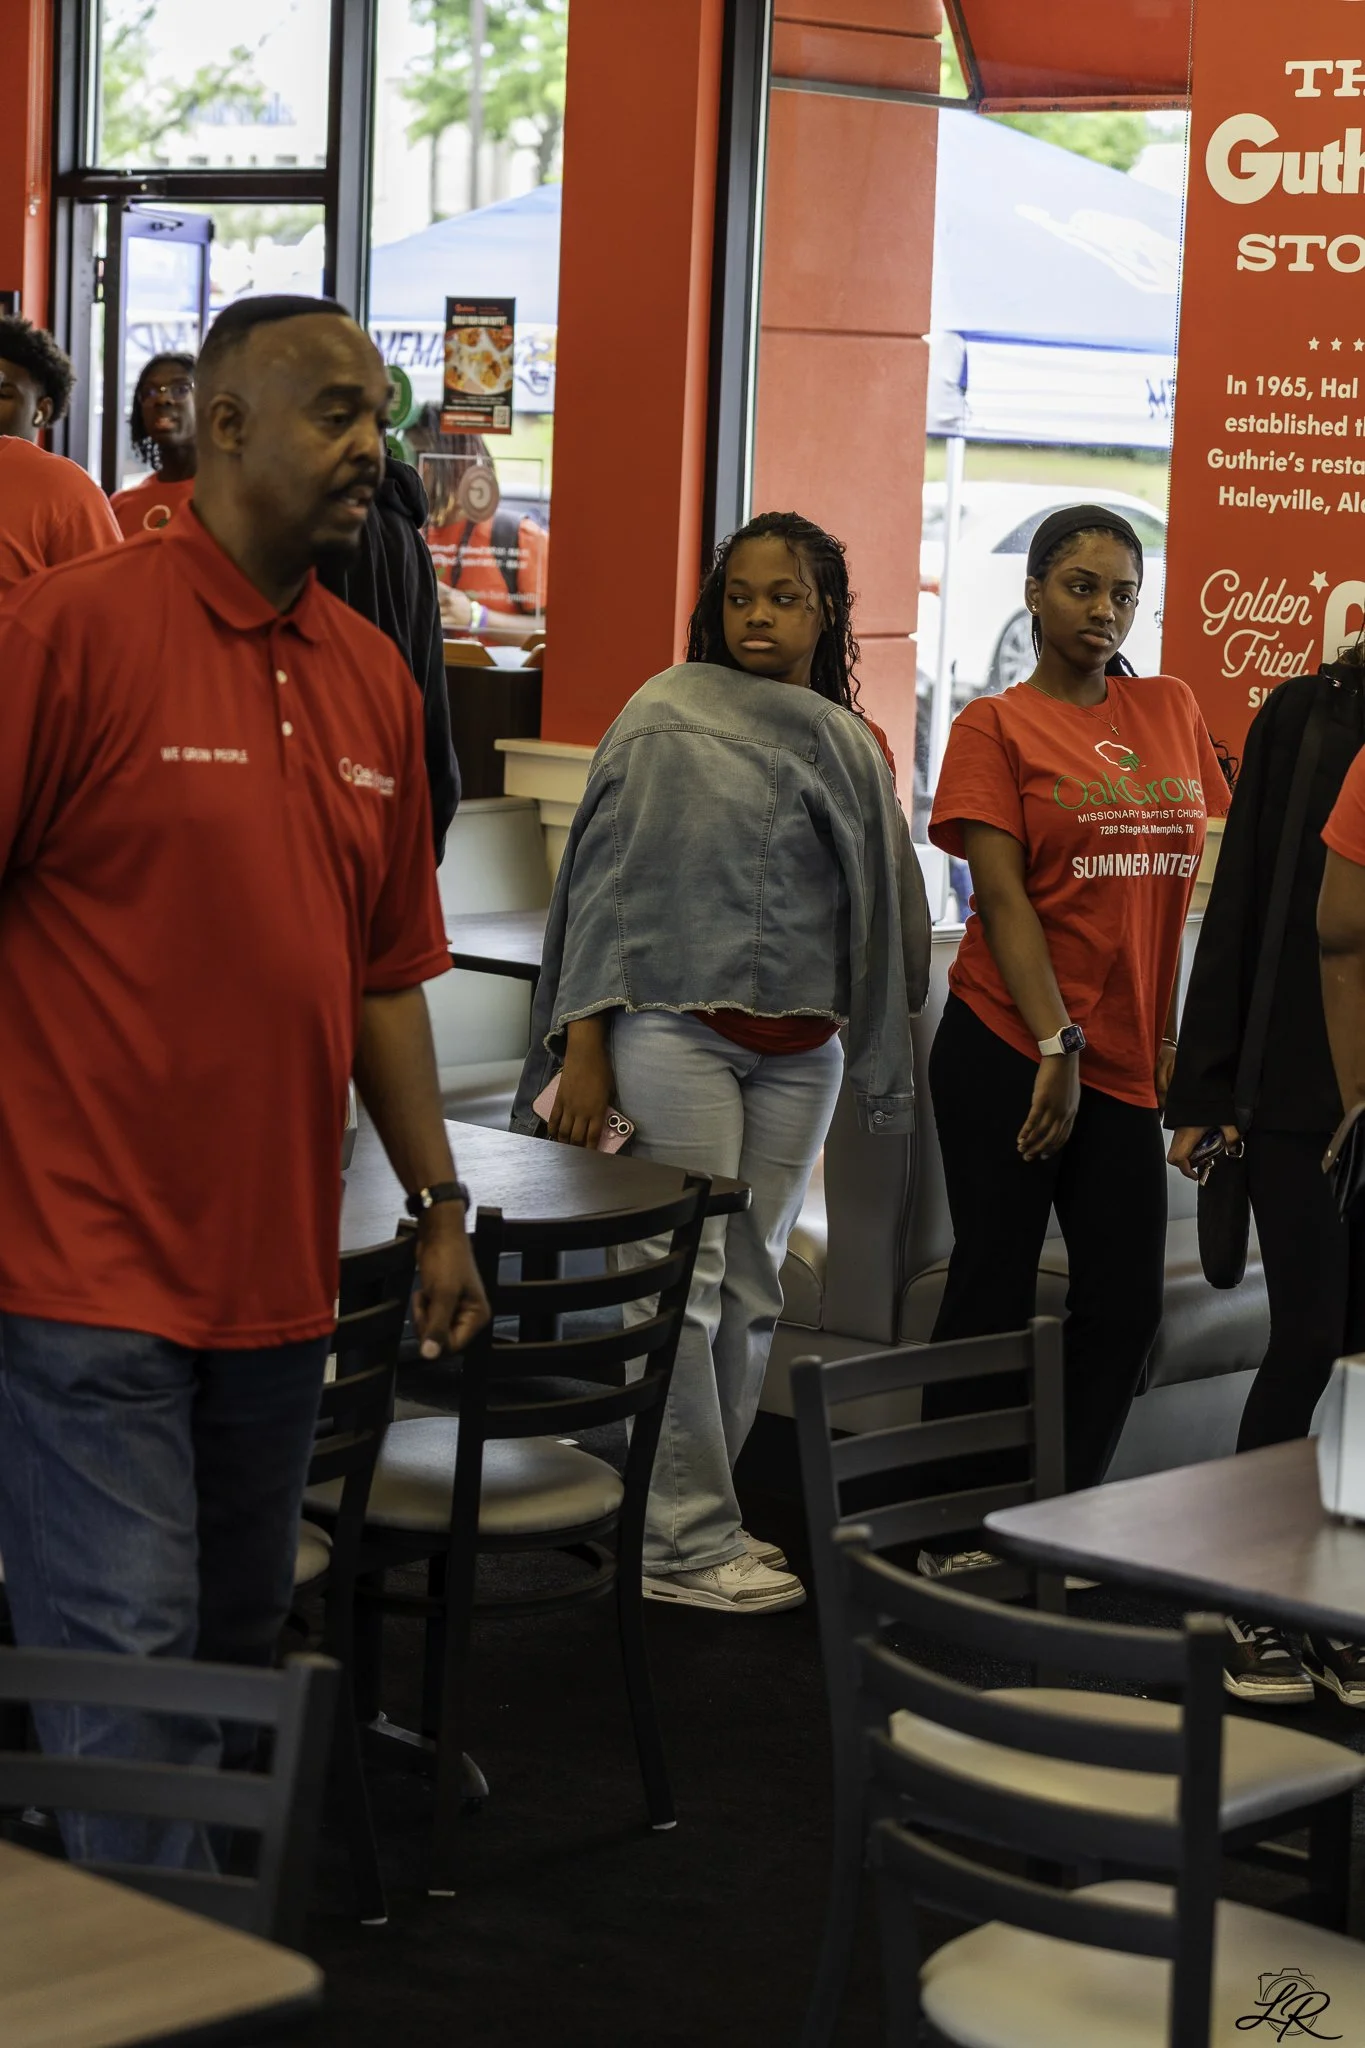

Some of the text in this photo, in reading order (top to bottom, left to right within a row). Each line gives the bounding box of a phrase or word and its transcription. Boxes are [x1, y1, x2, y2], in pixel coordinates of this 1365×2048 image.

[1237, 234, 1365, 273] STO
[1227, 375, 1358, 400] In 1965, Hal
[1225, 413, 1365, 437] established t
[1207, 449, 1365, 475] Guthrie's resta
[1219, 486, 1331, 515] Haleyville,
[1200, 569, 1312, 635] Golden
[1221, 629, 1314, 677] Fried
[1078, 810, 1140, 823] MISSIONARY
[1142, 810, 1175, 819] BAPTIST
[1100, 825, 1118, 835] 7289
[1120, 824, 1140, 836] Stage
[1151, 823, 1183, 836] Memphis,
[1072, 853, 1149, 879] SUMMER
